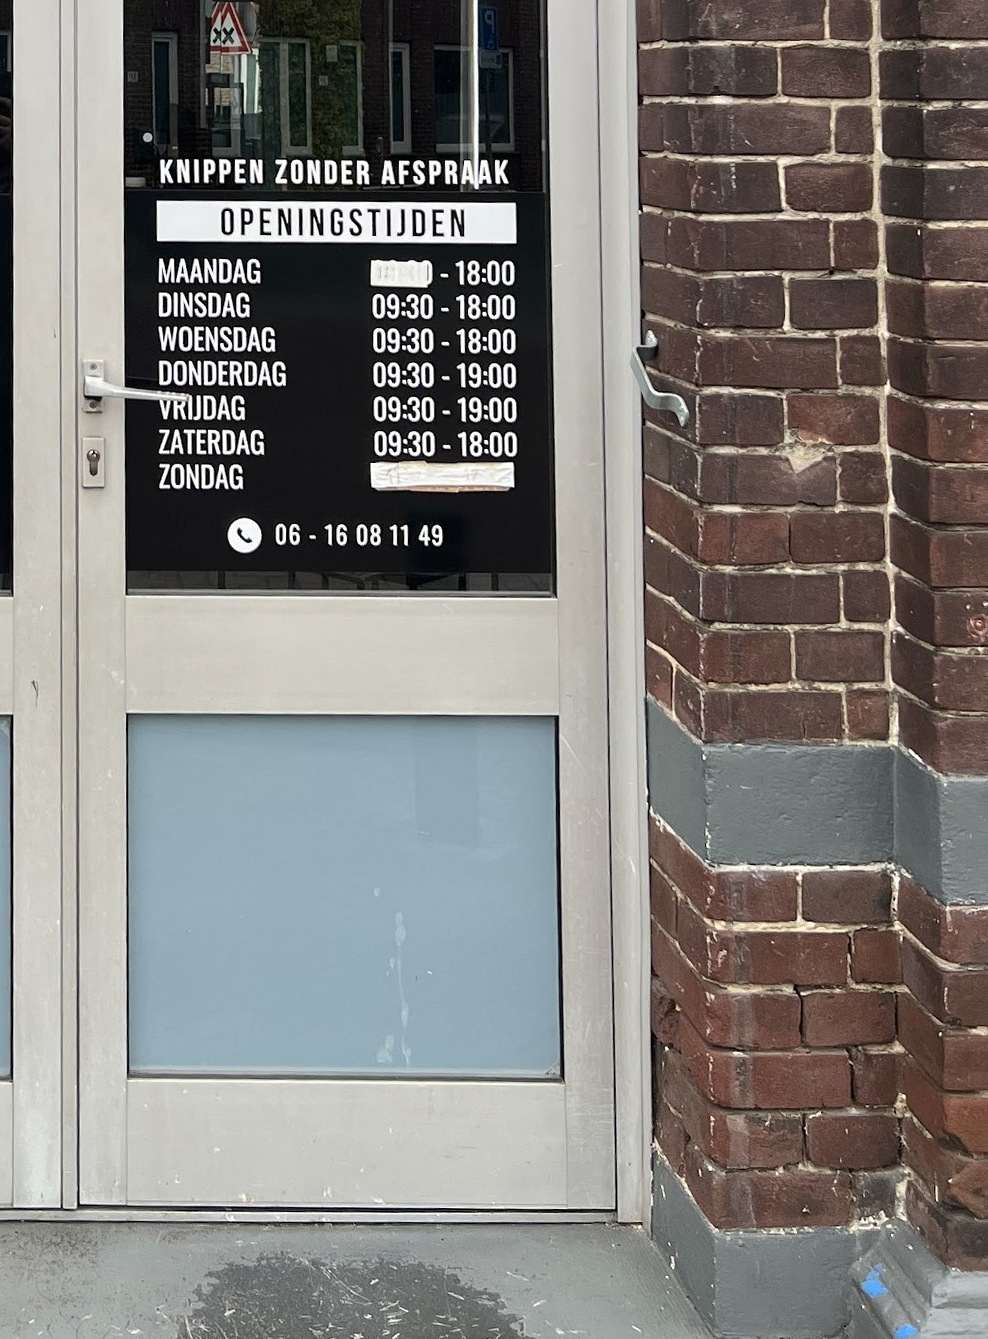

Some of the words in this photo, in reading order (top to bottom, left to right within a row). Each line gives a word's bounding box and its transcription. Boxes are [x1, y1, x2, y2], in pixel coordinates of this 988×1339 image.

[160, 159, 263, 183] KNIPPEN
[275, 160, 369, 184] ZONDER
[381, 160, 509, 185] AFSPRAAK
[221, 208, 464, 237] OPENINGSTIJDEN
[159, 258, 260, 284] MAANDAG
[455, 260, 515, 285] 18:00
[159, 292, 250, 318] DINSDAG
[372, 294, 433, 319] 09:30
[456, 295, 515, 319] 18:00
[158, 326, 276, 352] WOENSDAG
[373, 328, 434, 353] 09:30
[456, 329, 516, 354] 18:00
[159, 360, 286, 386] DONDERDAG
[373, 362, 434, 388] 09:30
[457, 363, 516, 388] 19:00
[159, 395, 246, 421] VRIJDAG
[374, 396, 434, 422] 09:30
[458, 397, 517, 422] 19:00
[159, 429, 264, 455] ZATERDAG
[374, 431, 435, 456] 09:30
[458, 432, 517, 457] 18:00
[159, 464, 243, 489] ZONDAG
[276, 524, 300, 545] 06
[325, 524, 347, 546] 16
[357, 524, 381, 546] 08
[390, 525, 408, 546] 11
[419, 525, 443, 546] 49
